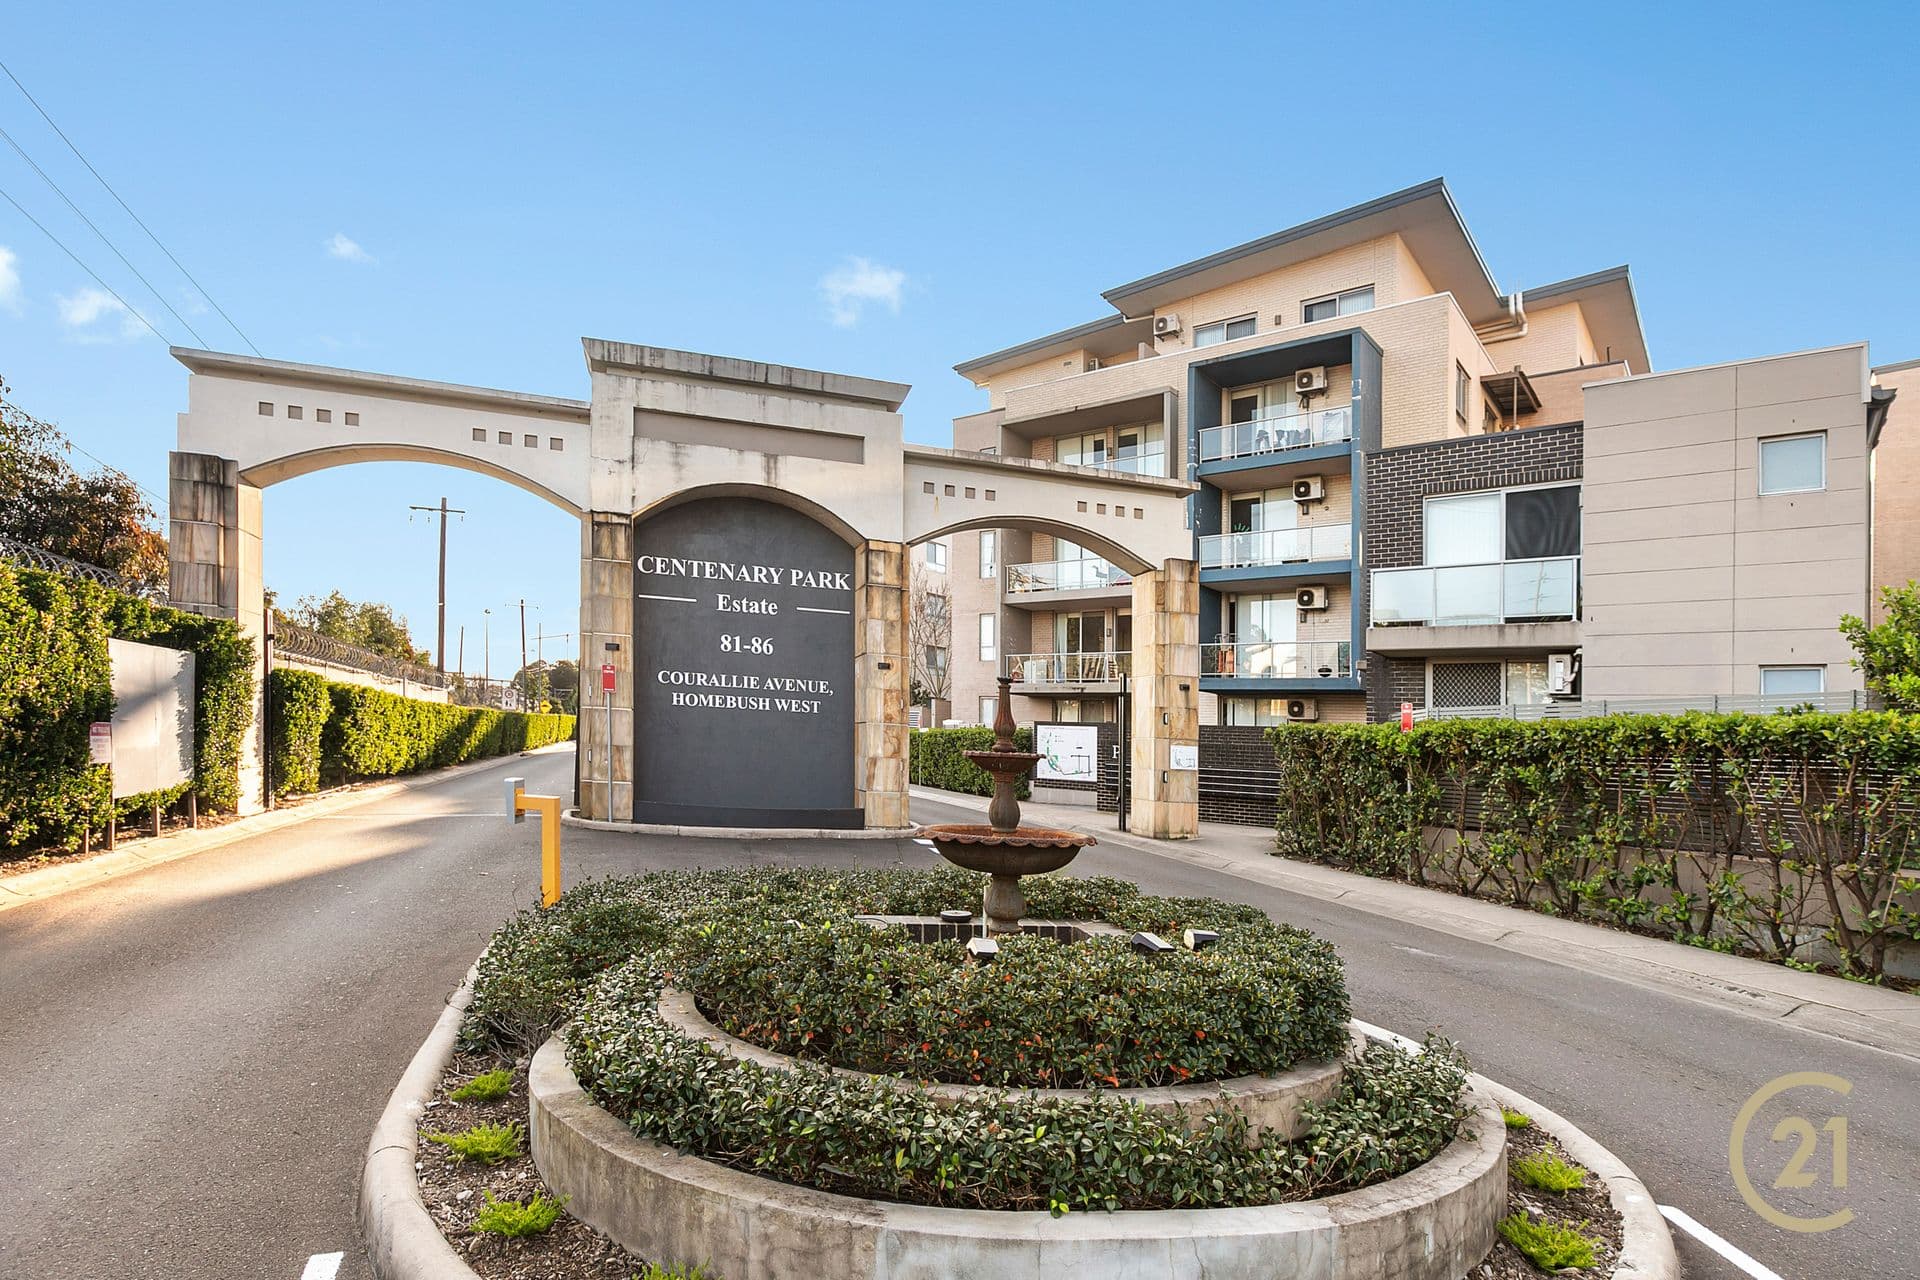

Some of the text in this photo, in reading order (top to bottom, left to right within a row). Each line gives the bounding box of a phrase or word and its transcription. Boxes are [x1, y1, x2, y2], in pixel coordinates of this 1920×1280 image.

[637, 555, 851, 591] CENTENARY PARK
[715, 593, 778, 616] Estate
[720, 634, 774, 655] 81-86
[657, 670, 834, 697] COURALLIE AVENUE,
[671, 691, 822, 714] HOMEBUSH WEST
